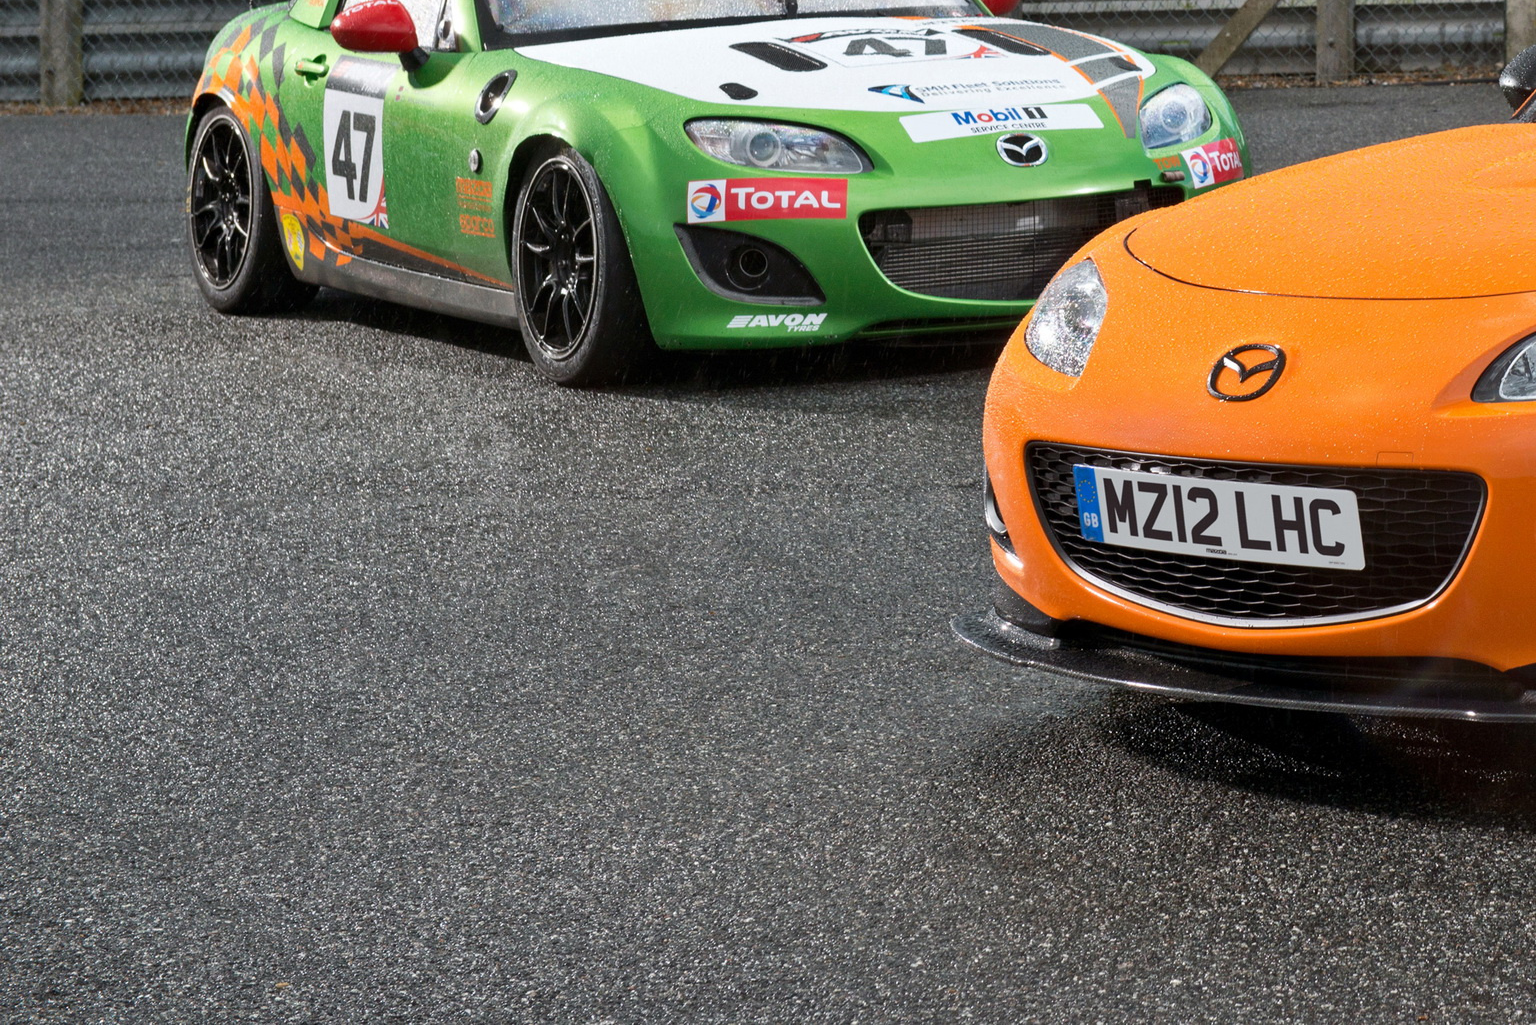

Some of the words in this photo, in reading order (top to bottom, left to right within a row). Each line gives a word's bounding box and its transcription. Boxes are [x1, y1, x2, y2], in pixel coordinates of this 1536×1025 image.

[842, 37, 947, 57] 47
[951, 81, 988, 90] Fleet
[992, 79, 1060, 87] Solutions
[951, 107, 1022, 126] Mobil
[970, 124, 1010, 134] SERVICE
[1011, 122, 1047, 130] CENTRE
[332, 109, 376, 203] 47
[731, 187, 841, 210] TOTAL
[748, 313, 827, 328] AVON
[787, 324, 820, 333] TYRES
[1083, 512, 1099, 528] GB
[1103, 477, 1223, 547] MZ12
[1234, 491, 1345, 557] LHC
